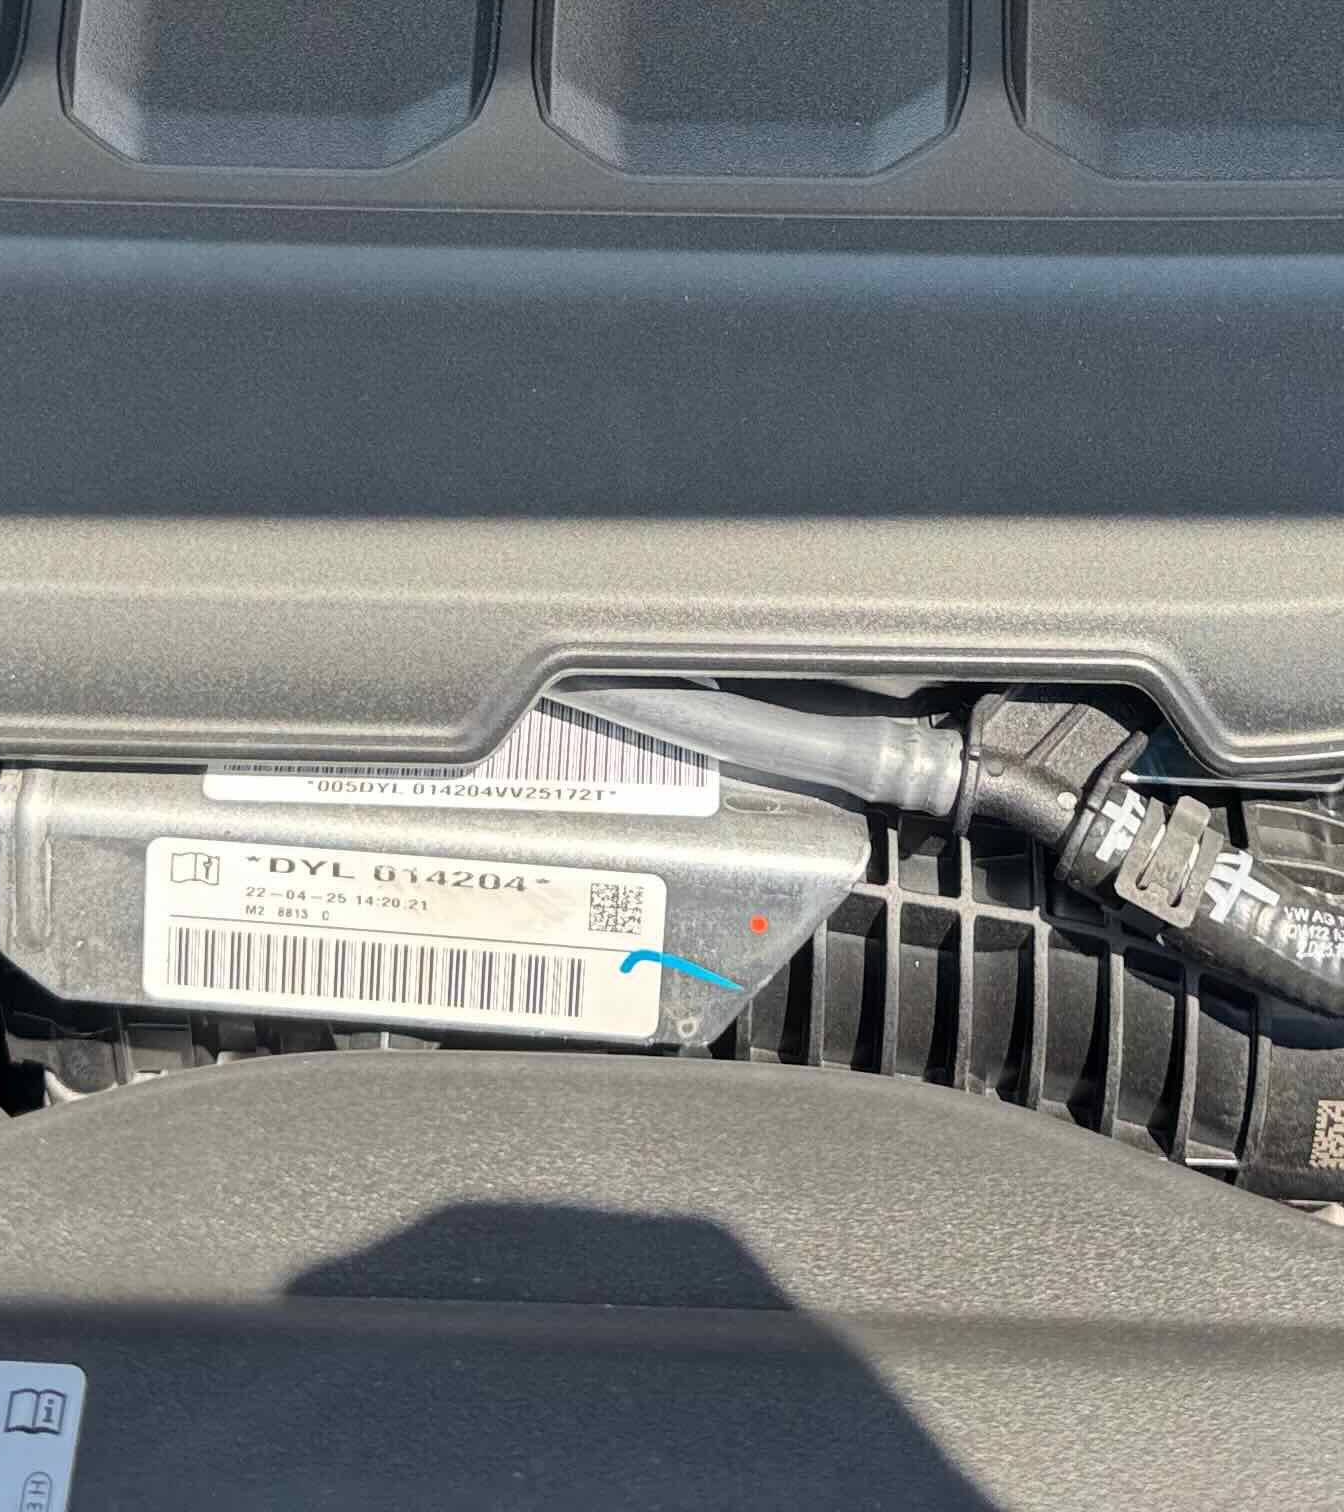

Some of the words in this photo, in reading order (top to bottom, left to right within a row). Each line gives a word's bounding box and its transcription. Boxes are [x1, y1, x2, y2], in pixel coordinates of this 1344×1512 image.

[245, 904, 265, 917] M2
[1284, 906, 1309, 921] VW
[1312, 909, 1335, 926] AG
